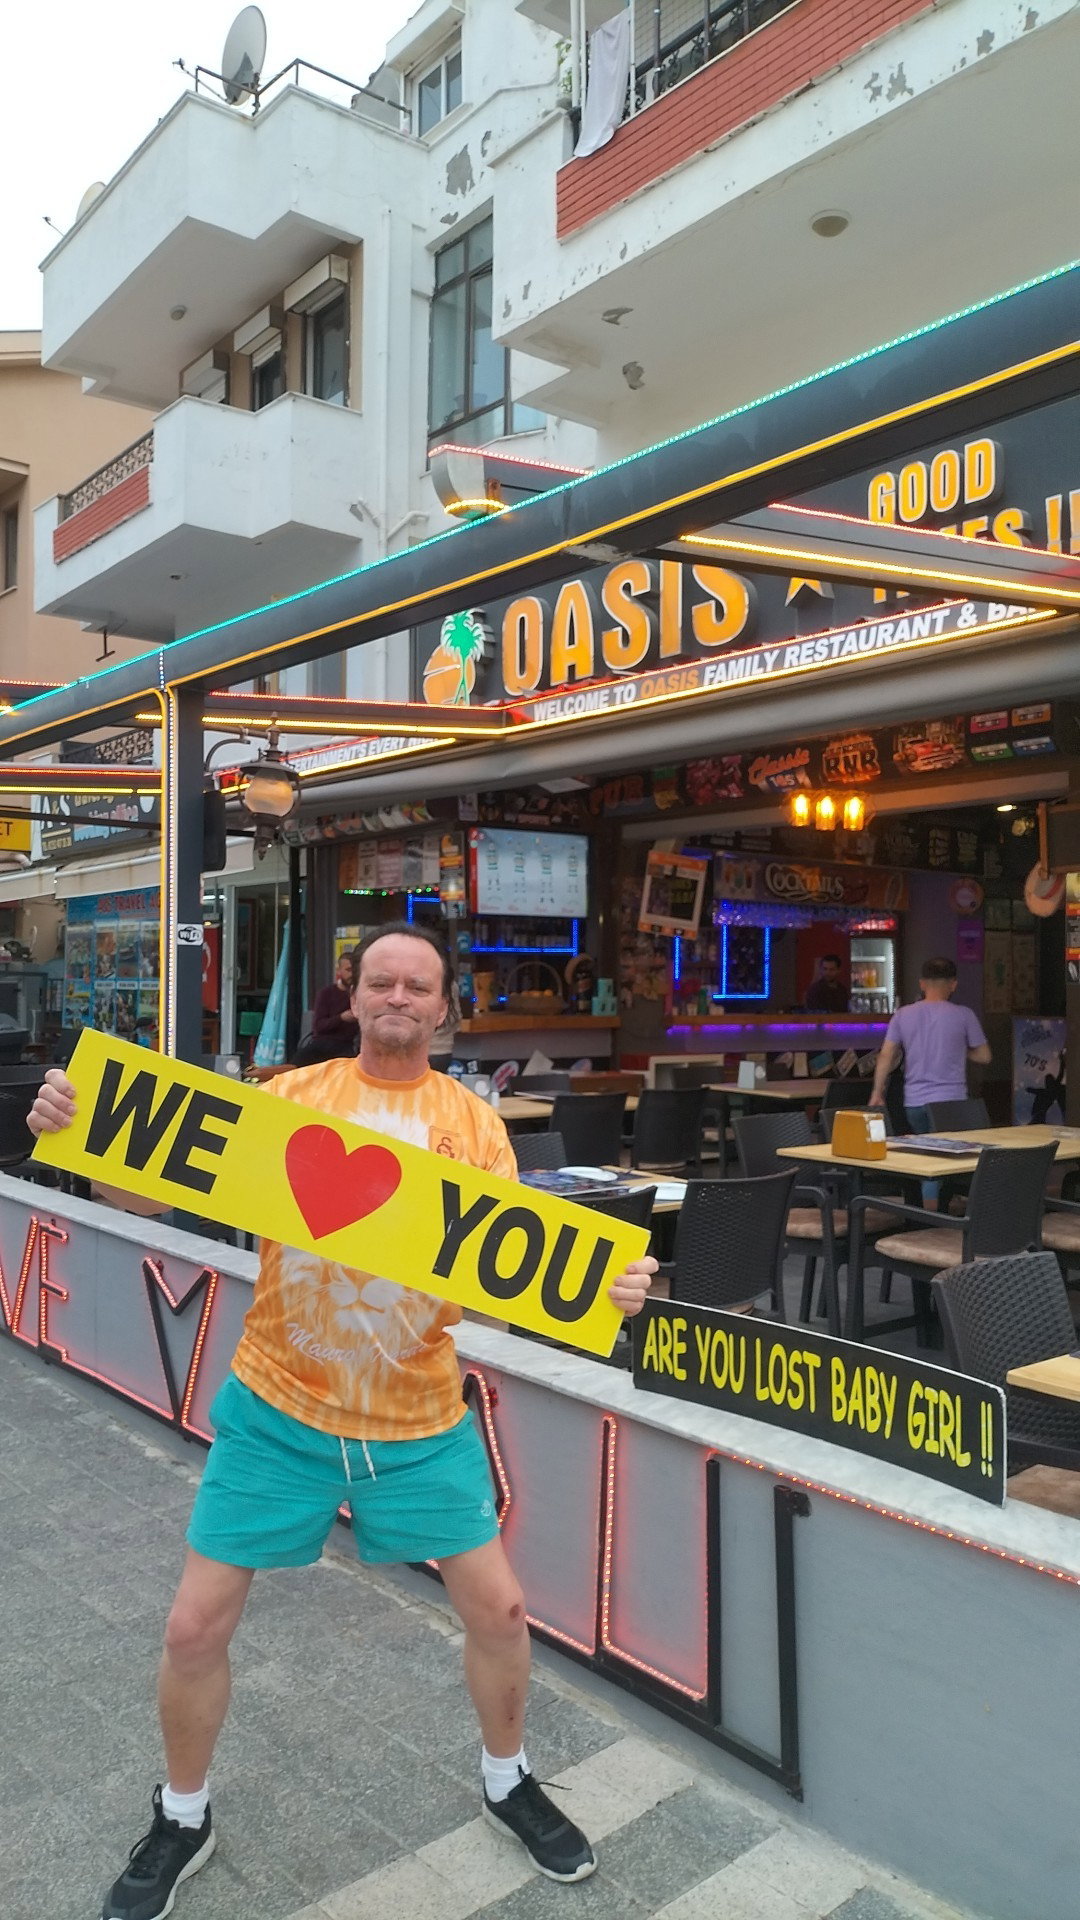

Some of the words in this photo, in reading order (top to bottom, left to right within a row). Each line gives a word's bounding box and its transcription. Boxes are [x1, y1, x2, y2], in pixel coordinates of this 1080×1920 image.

[868, 438, 996, 524] GOOD
[502, 560, 750, 696] OASIS
[533, 691, 611, 722] WELCOME
[612, 684, 636, 706] TO
[640, 669, 699, 699] OASIS
[703, 649, 783, 687] FAMILY
[783, 608, 951, 669] RESTAURANT
[956, 602, 978, 629] &
[84, 1058, 244, 1195] WE
[431, 1179, 615, 1323] YOU
[642, 1316, 688, 1382] ARE
[694, 1323, 746, 1395] YOU
[755, 1337, 822, 1413] LOST
[831, 1356, 898, 1440] BABY
[907, 1380, 972, 1468] GIRL
[979, 1400, 994, 1479] !!
